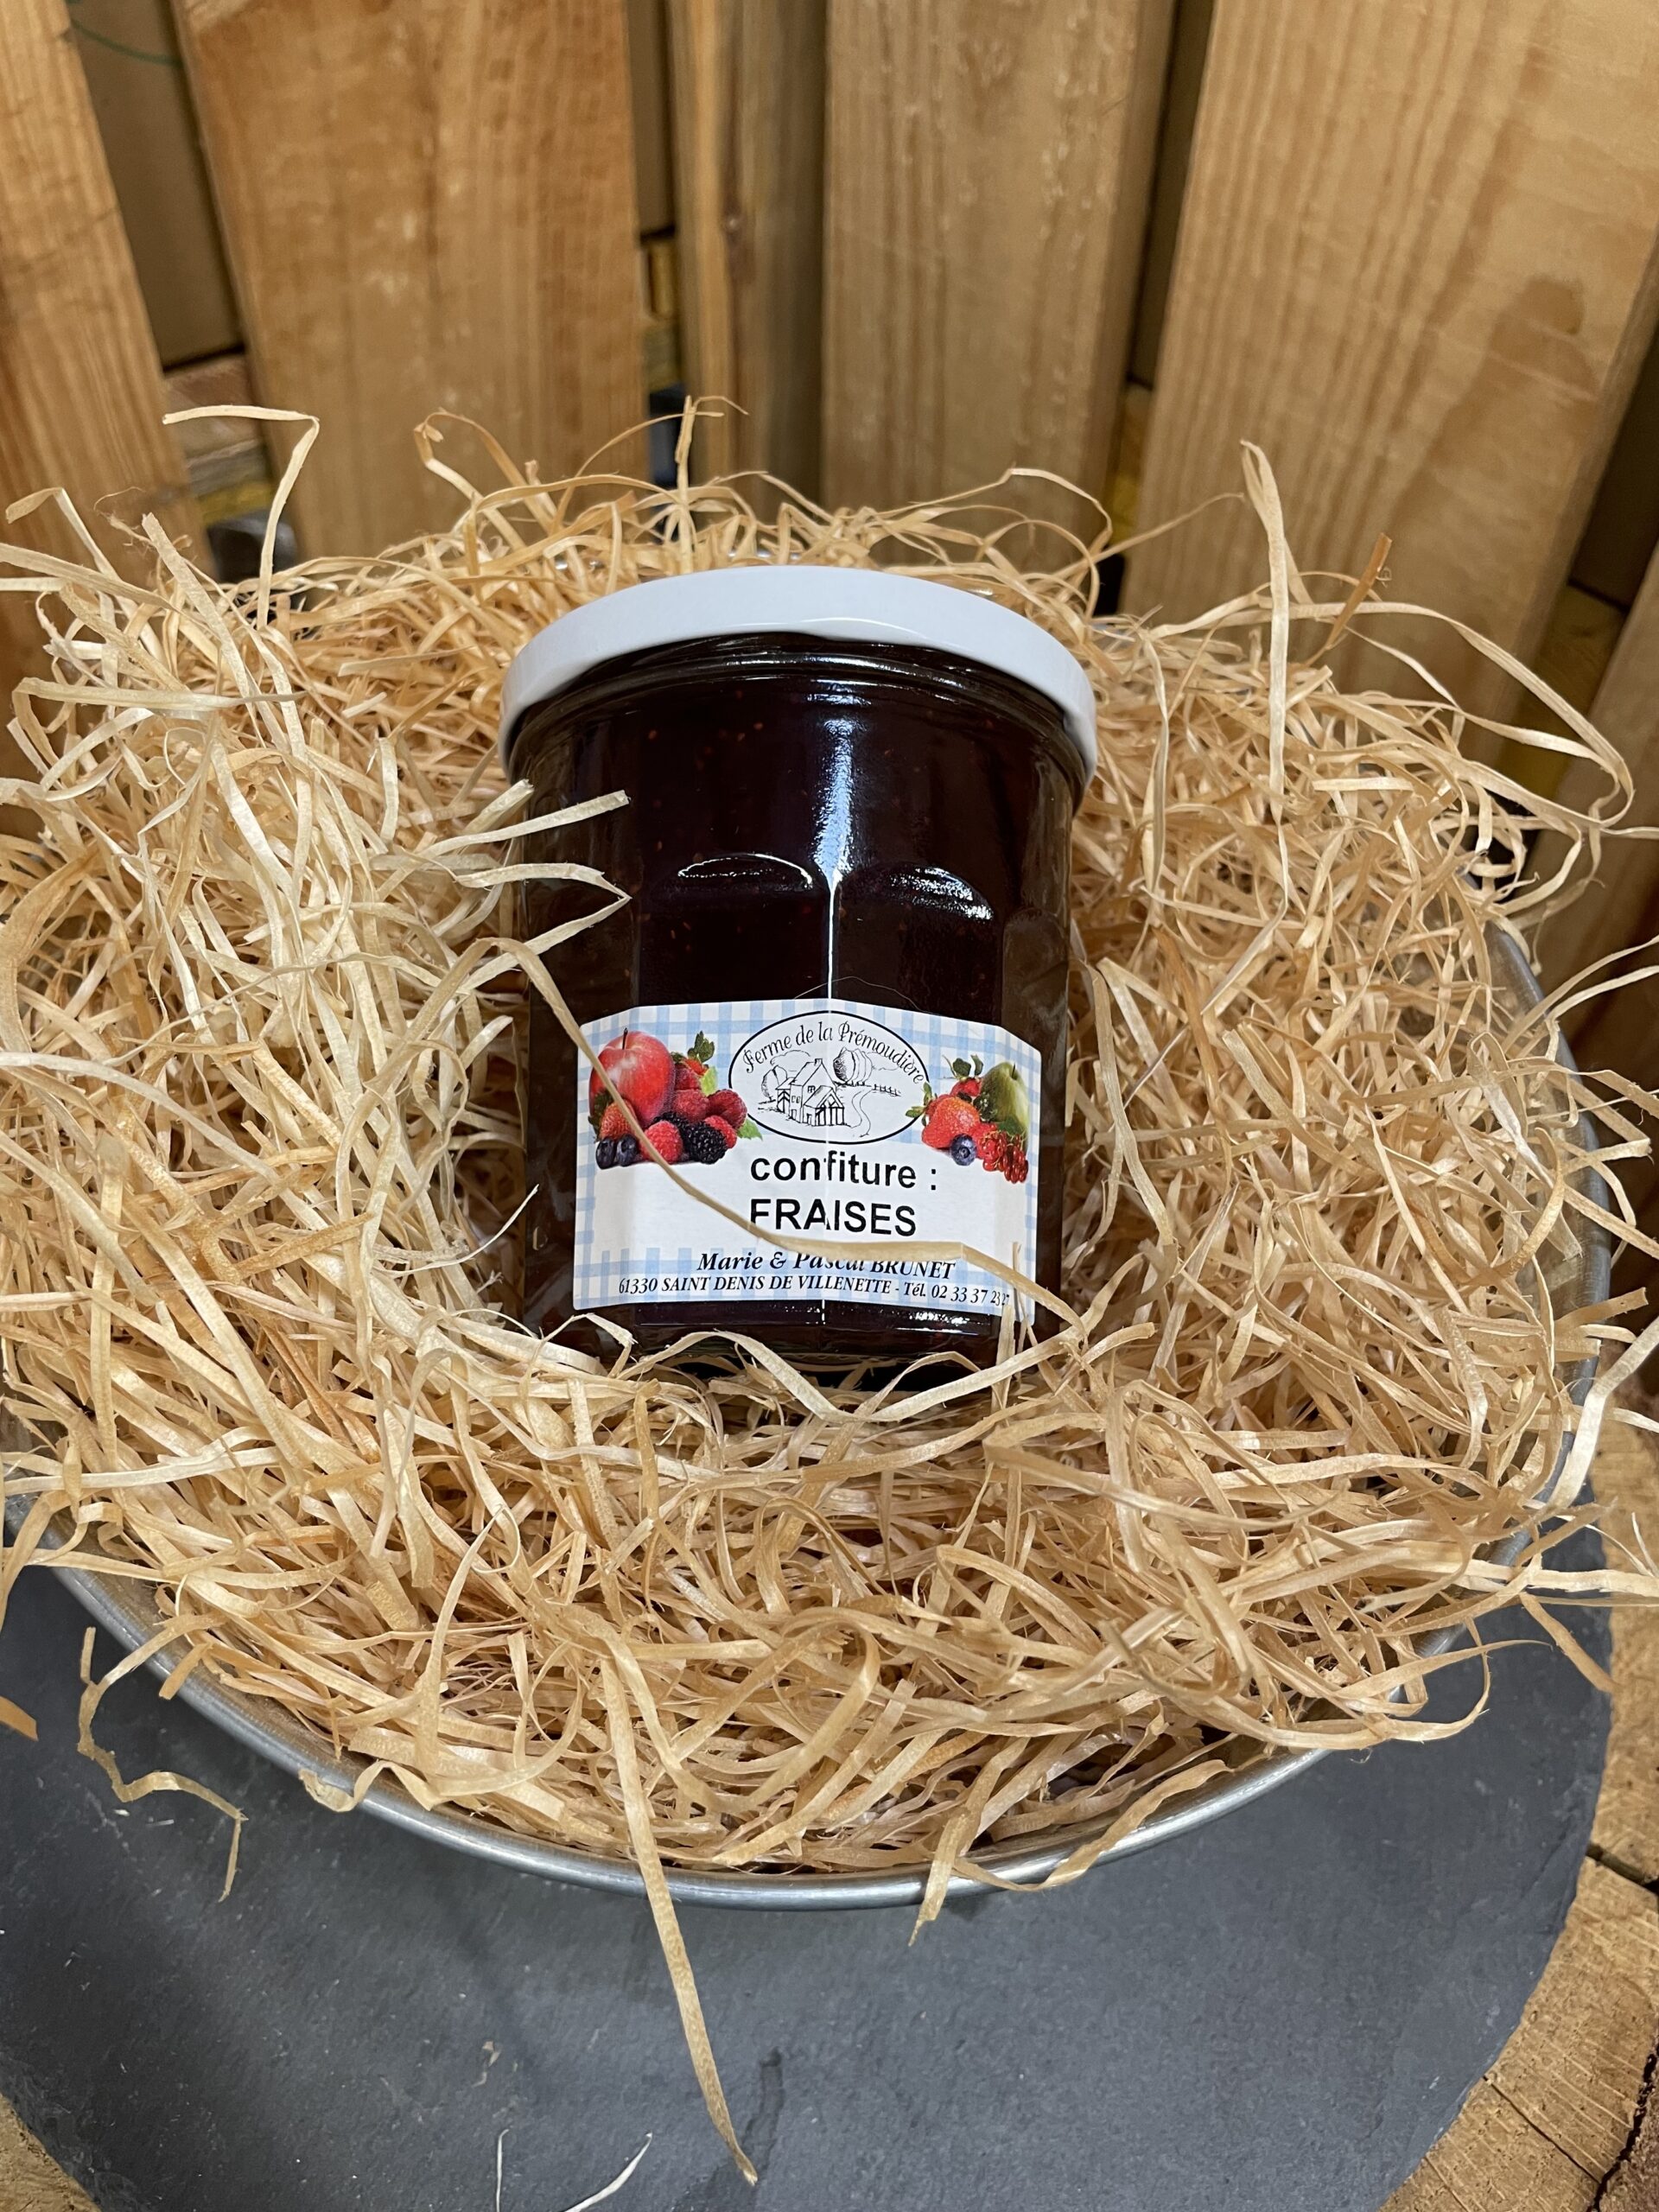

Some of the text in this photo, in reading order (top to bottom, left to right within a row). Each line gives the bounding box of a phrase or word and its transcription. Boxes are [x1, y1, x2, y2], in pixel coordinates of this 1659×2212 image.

[743, 1020, 924, 1084] Ferme de la Prémoudière
[750, 1150, 937, 1191] confiture :
[750, 1198, 916, 1236] FRAISES
[697, 1253, 763, 1270] Marie
[770, 1251, 786, 1268] &
[870, 1261, 956, 1281] BRUNET
[619, 1277, 658, 1294] 61330
[662, 1276, 711, 1292] SAINT
[713, 1276, 765, 1290] DENIS
[769, 1275, 793, 1290] DE
[798, 1274, 892, 1294] VILLENETTE
[904, 1281, 926, 1298] Tél.
[931, 1284, 947, 1300] 02
[950, 1286, 968, 1302] 33
[969, 1288, 988, 1303] 37
[990, 1290, 1001, 1306] 23
